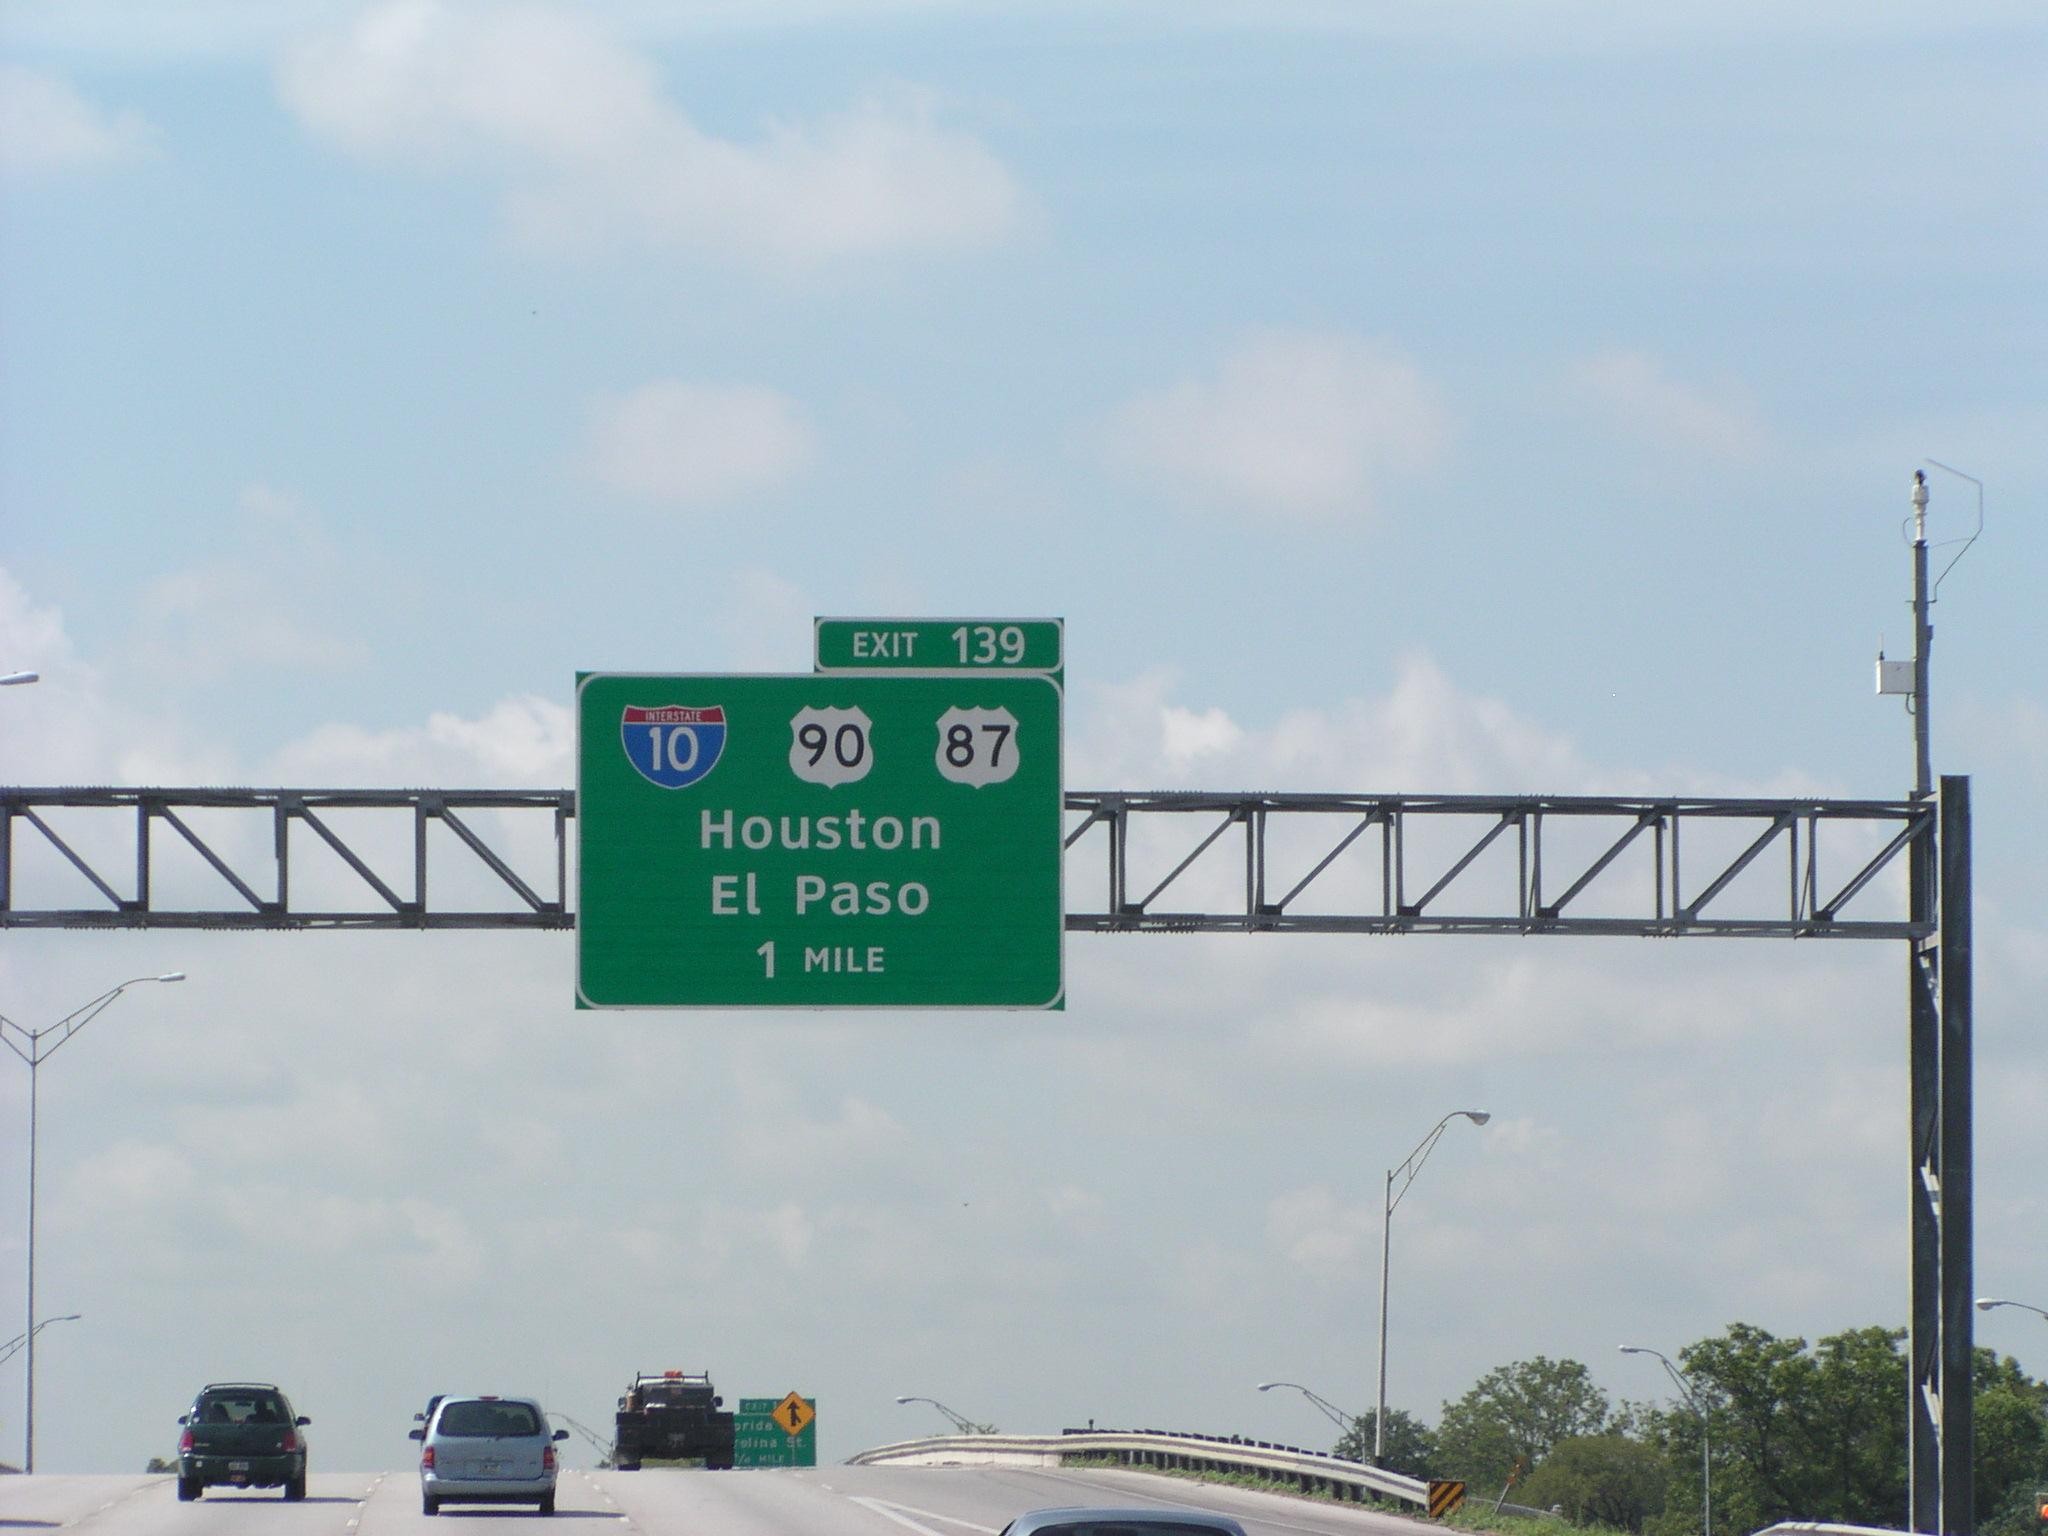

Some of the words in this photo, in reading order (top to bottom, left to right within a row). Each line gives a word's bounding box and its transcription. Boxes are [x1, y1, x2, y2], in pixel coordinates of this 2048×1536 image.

[853, 632, 918, 657] EXIT
[952, 627, 1025, 664] 139
[645, 711, 701, 722] INTERSTATE
[649, 727, 699, 772] 10
[799, 724, 865, 767] 90
[945, 724, 1010, 767] 87
[700, 809, 941, 850] Houston
[712, 874, 761, 915] El
[796, 877, 929, 916] Paso
[757, 941, 776, 978] 1
[805, 948, 884, 973] MILE
